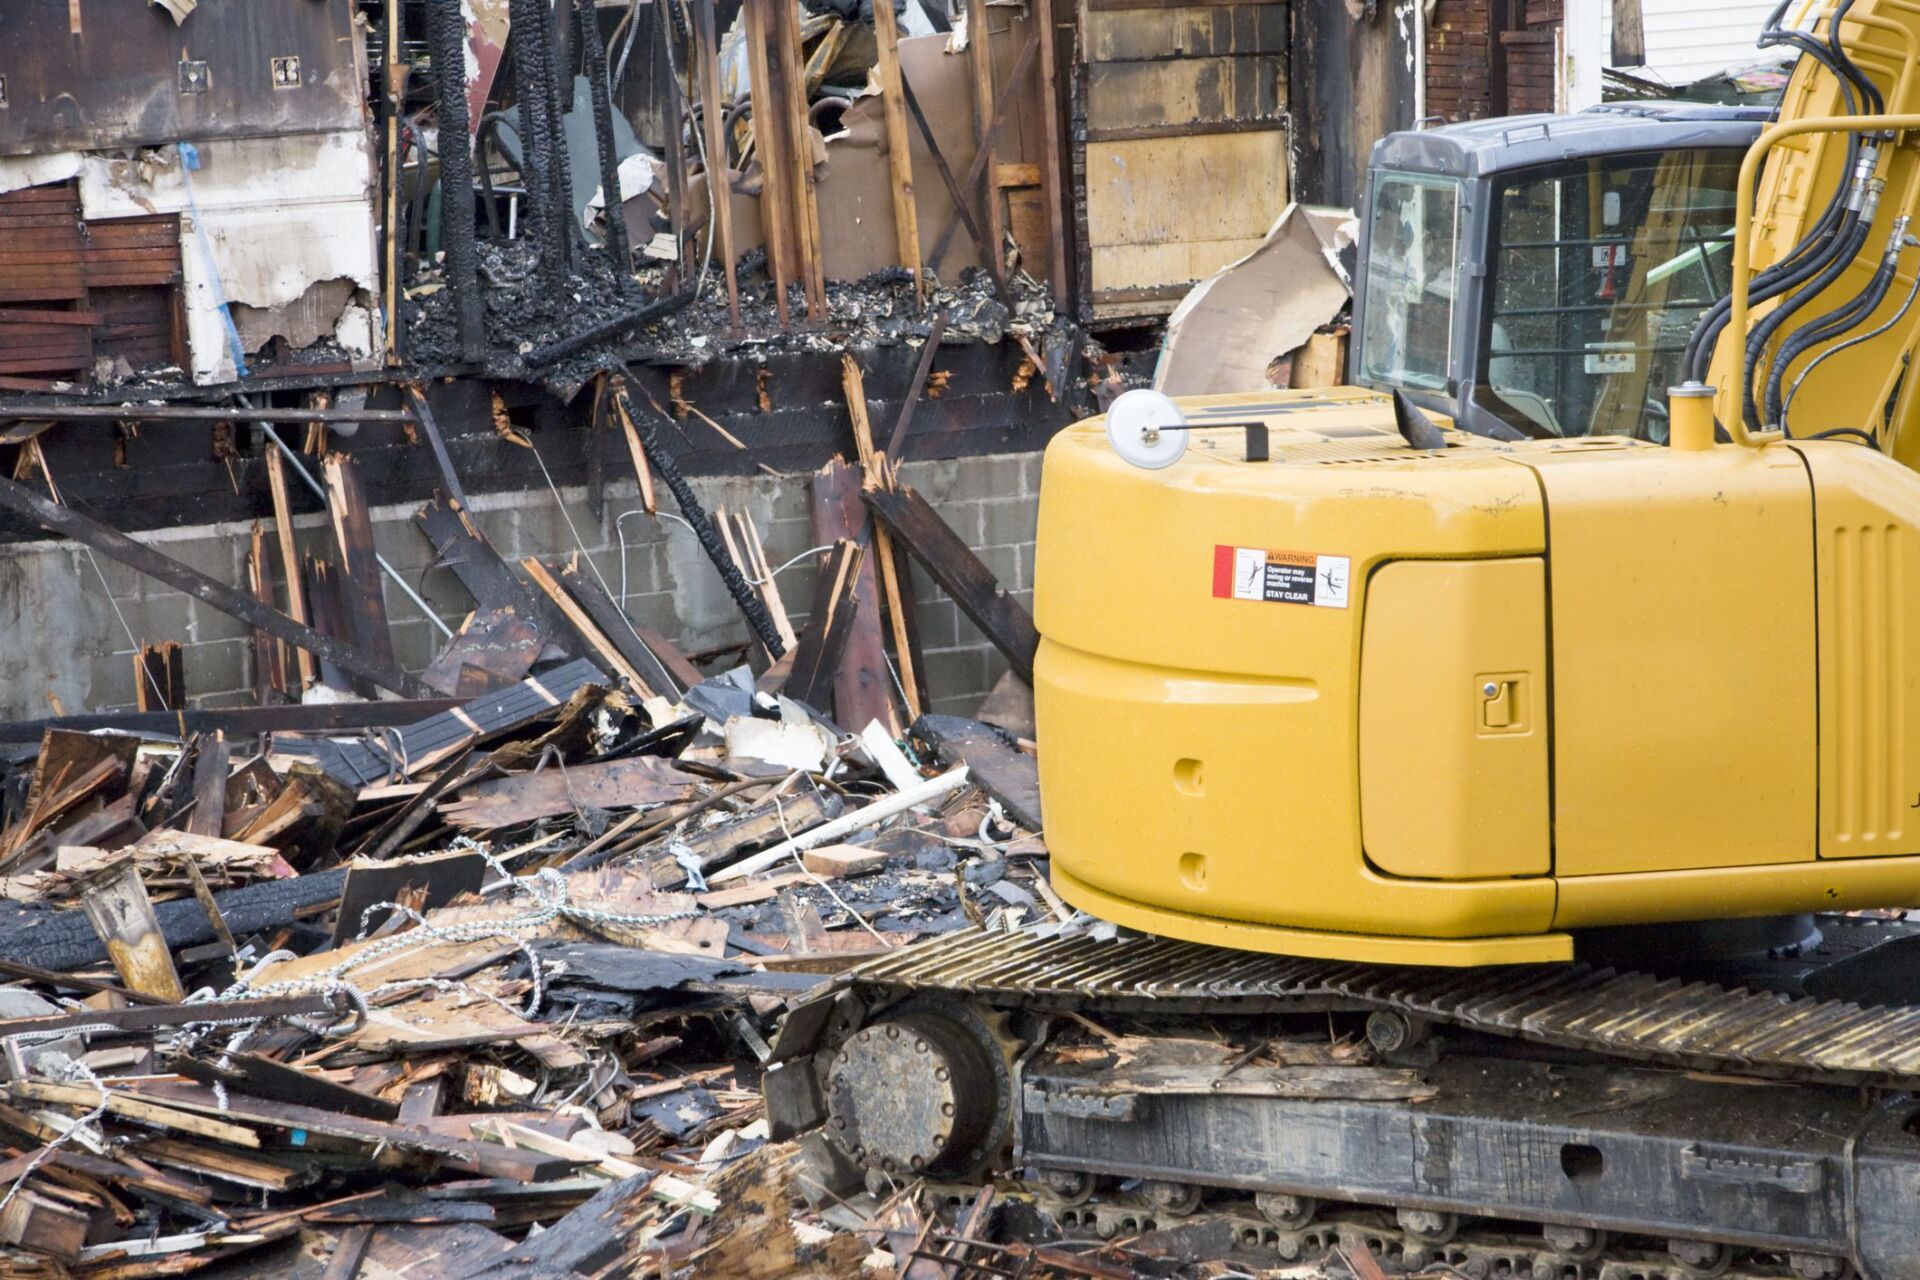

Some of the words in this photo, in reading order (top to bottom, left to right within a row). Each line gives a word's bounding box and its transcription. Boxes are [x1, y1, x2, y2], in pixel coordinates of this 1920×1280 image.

[1275, 553, 1315, 564] WARNING
[1267, 565, 1292, 574] Operator
[1266, 574, 1283, 582] swing
[1265, 590, 1284, 599] STAY
[1285, 591, 1308, 600] CLEAR
